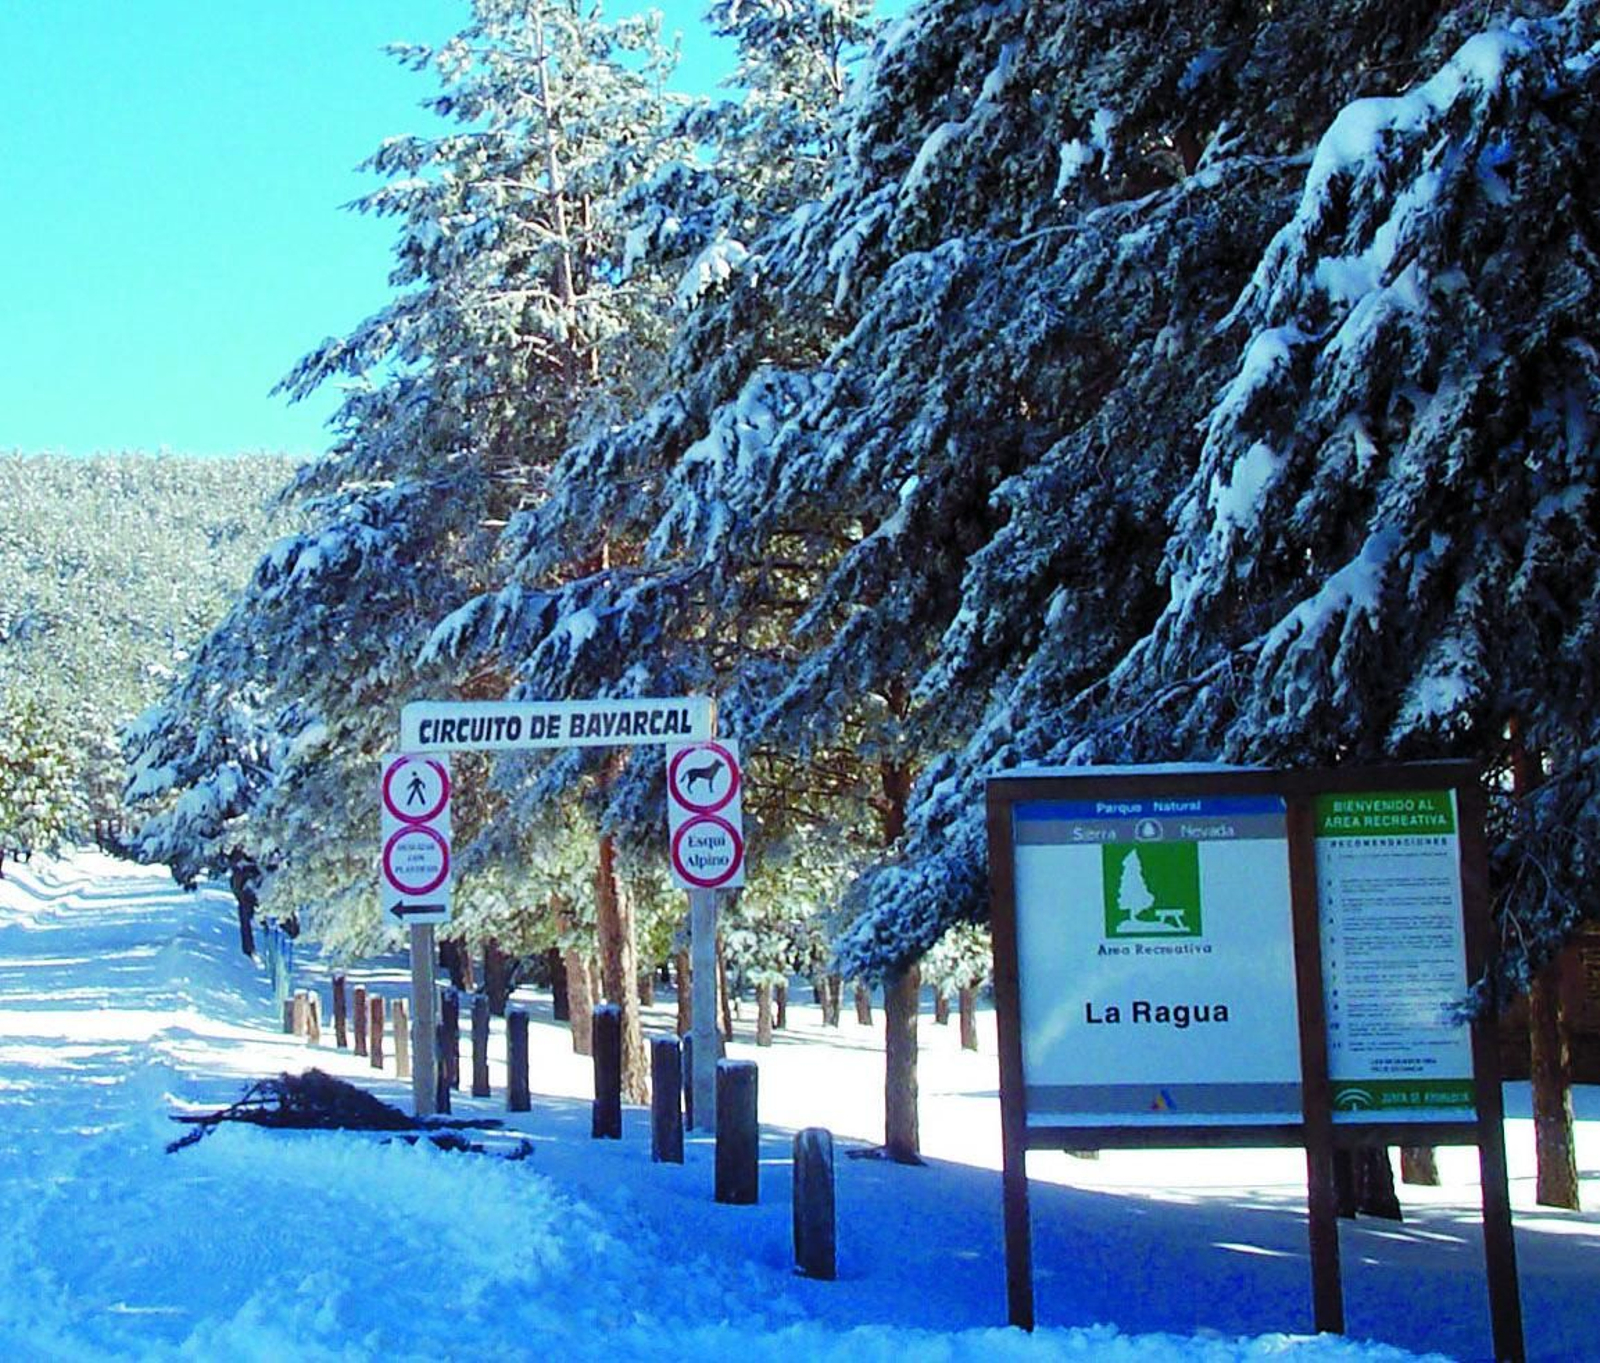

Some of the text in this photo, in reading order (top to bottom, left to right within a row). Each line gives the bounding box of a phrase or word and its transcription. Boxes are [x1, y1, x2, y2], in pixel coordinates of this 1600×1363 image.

[419, 715, 522, 744] CIRCUITO
[530, 714, 561, 741] DE
[1096, 800, 1202, 815] Parque Natural
[1333, 799, 1435, 812] BIENVENIDO AL
[1364, 814, 1447, 827] RECREATIVA
[1180, 824, 1235, 838] Nevada
[687, 853, 729, 869] Alpino
[1135, 943, 1212, 955] Recreativa
[1085, 1001, 1229, 1029] La Ragua
